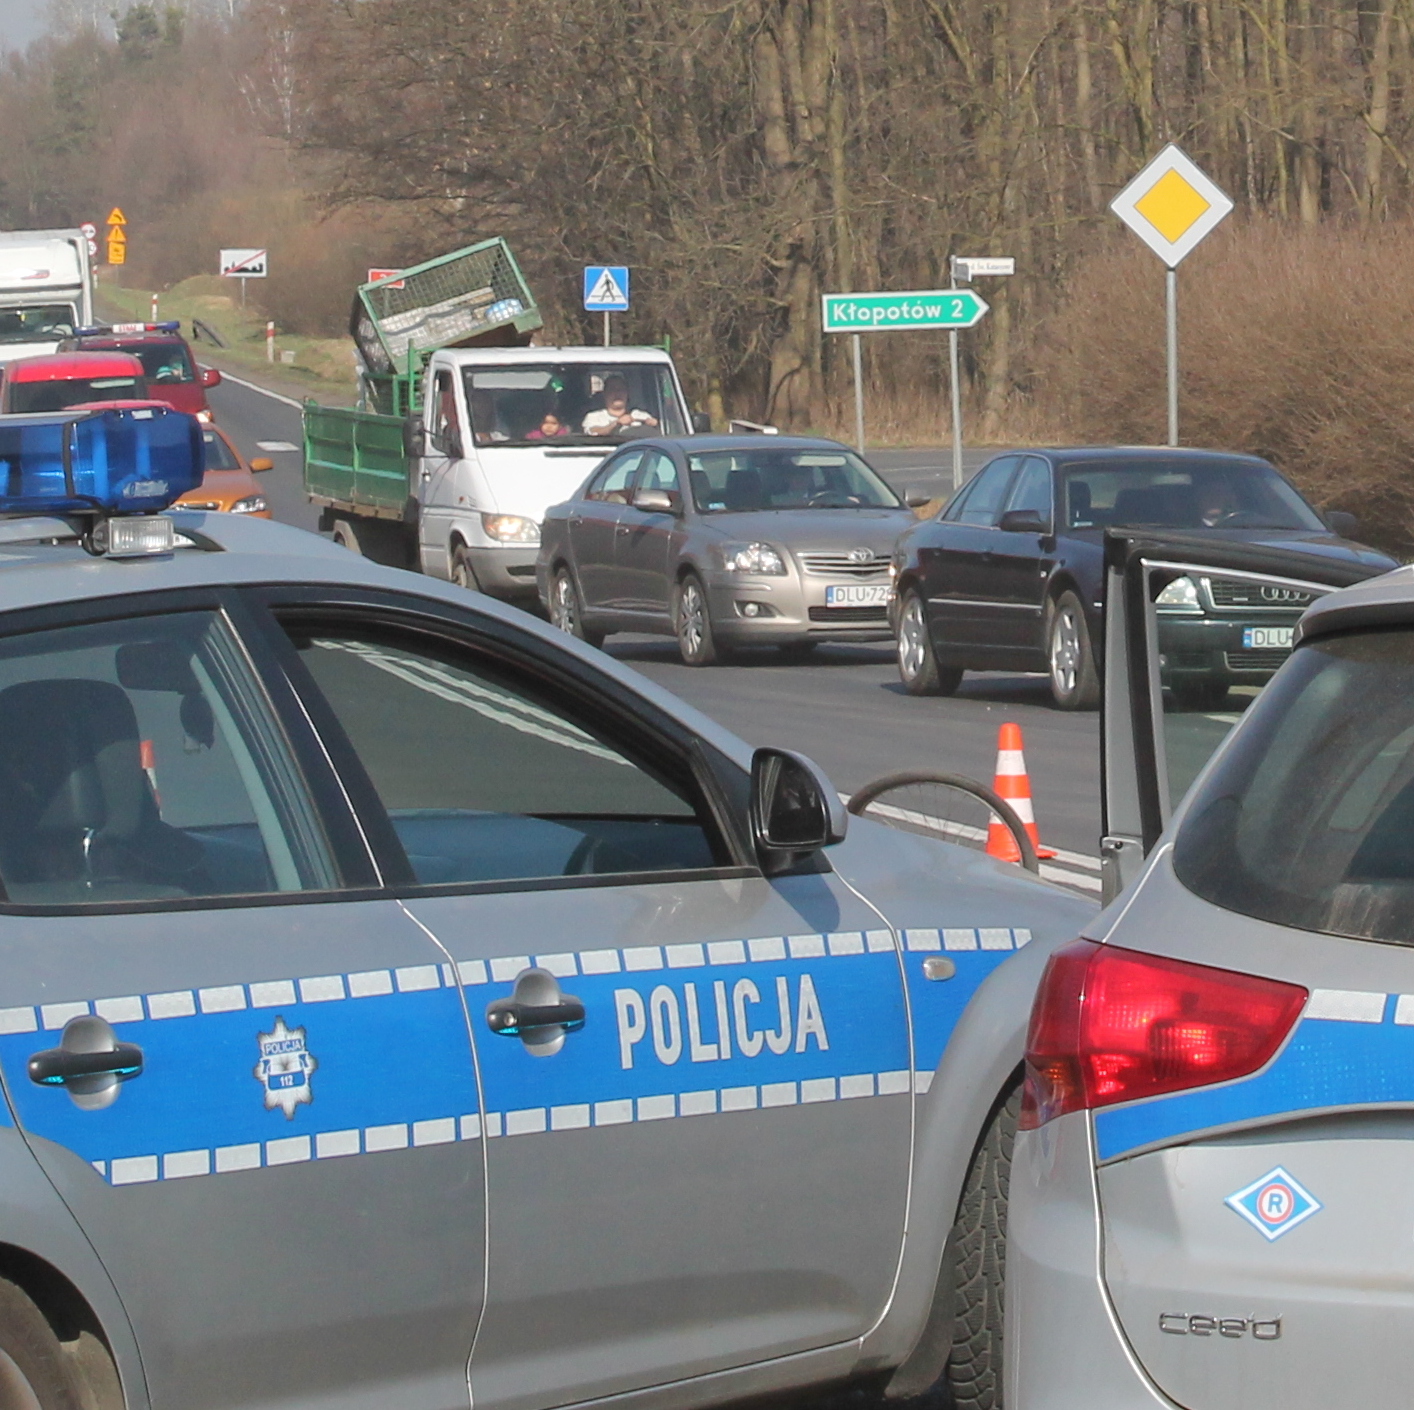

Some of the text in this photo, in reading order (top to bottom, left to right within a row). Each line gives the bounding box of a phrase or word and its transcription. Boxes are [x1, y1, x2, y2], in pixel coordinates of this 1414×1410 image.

[833, 299, 964, 326] Kłopotów 2
[836, 587, 866, 602] DLU
[1254, 630, 1289, 646] DLU
[614, 974, 829, 1069] POLICJA
[265, 1039, 302, 1055] POLICJA
[279, 1074, 294, 1087] 112
[1267, 1193, 1283, 1214] R
